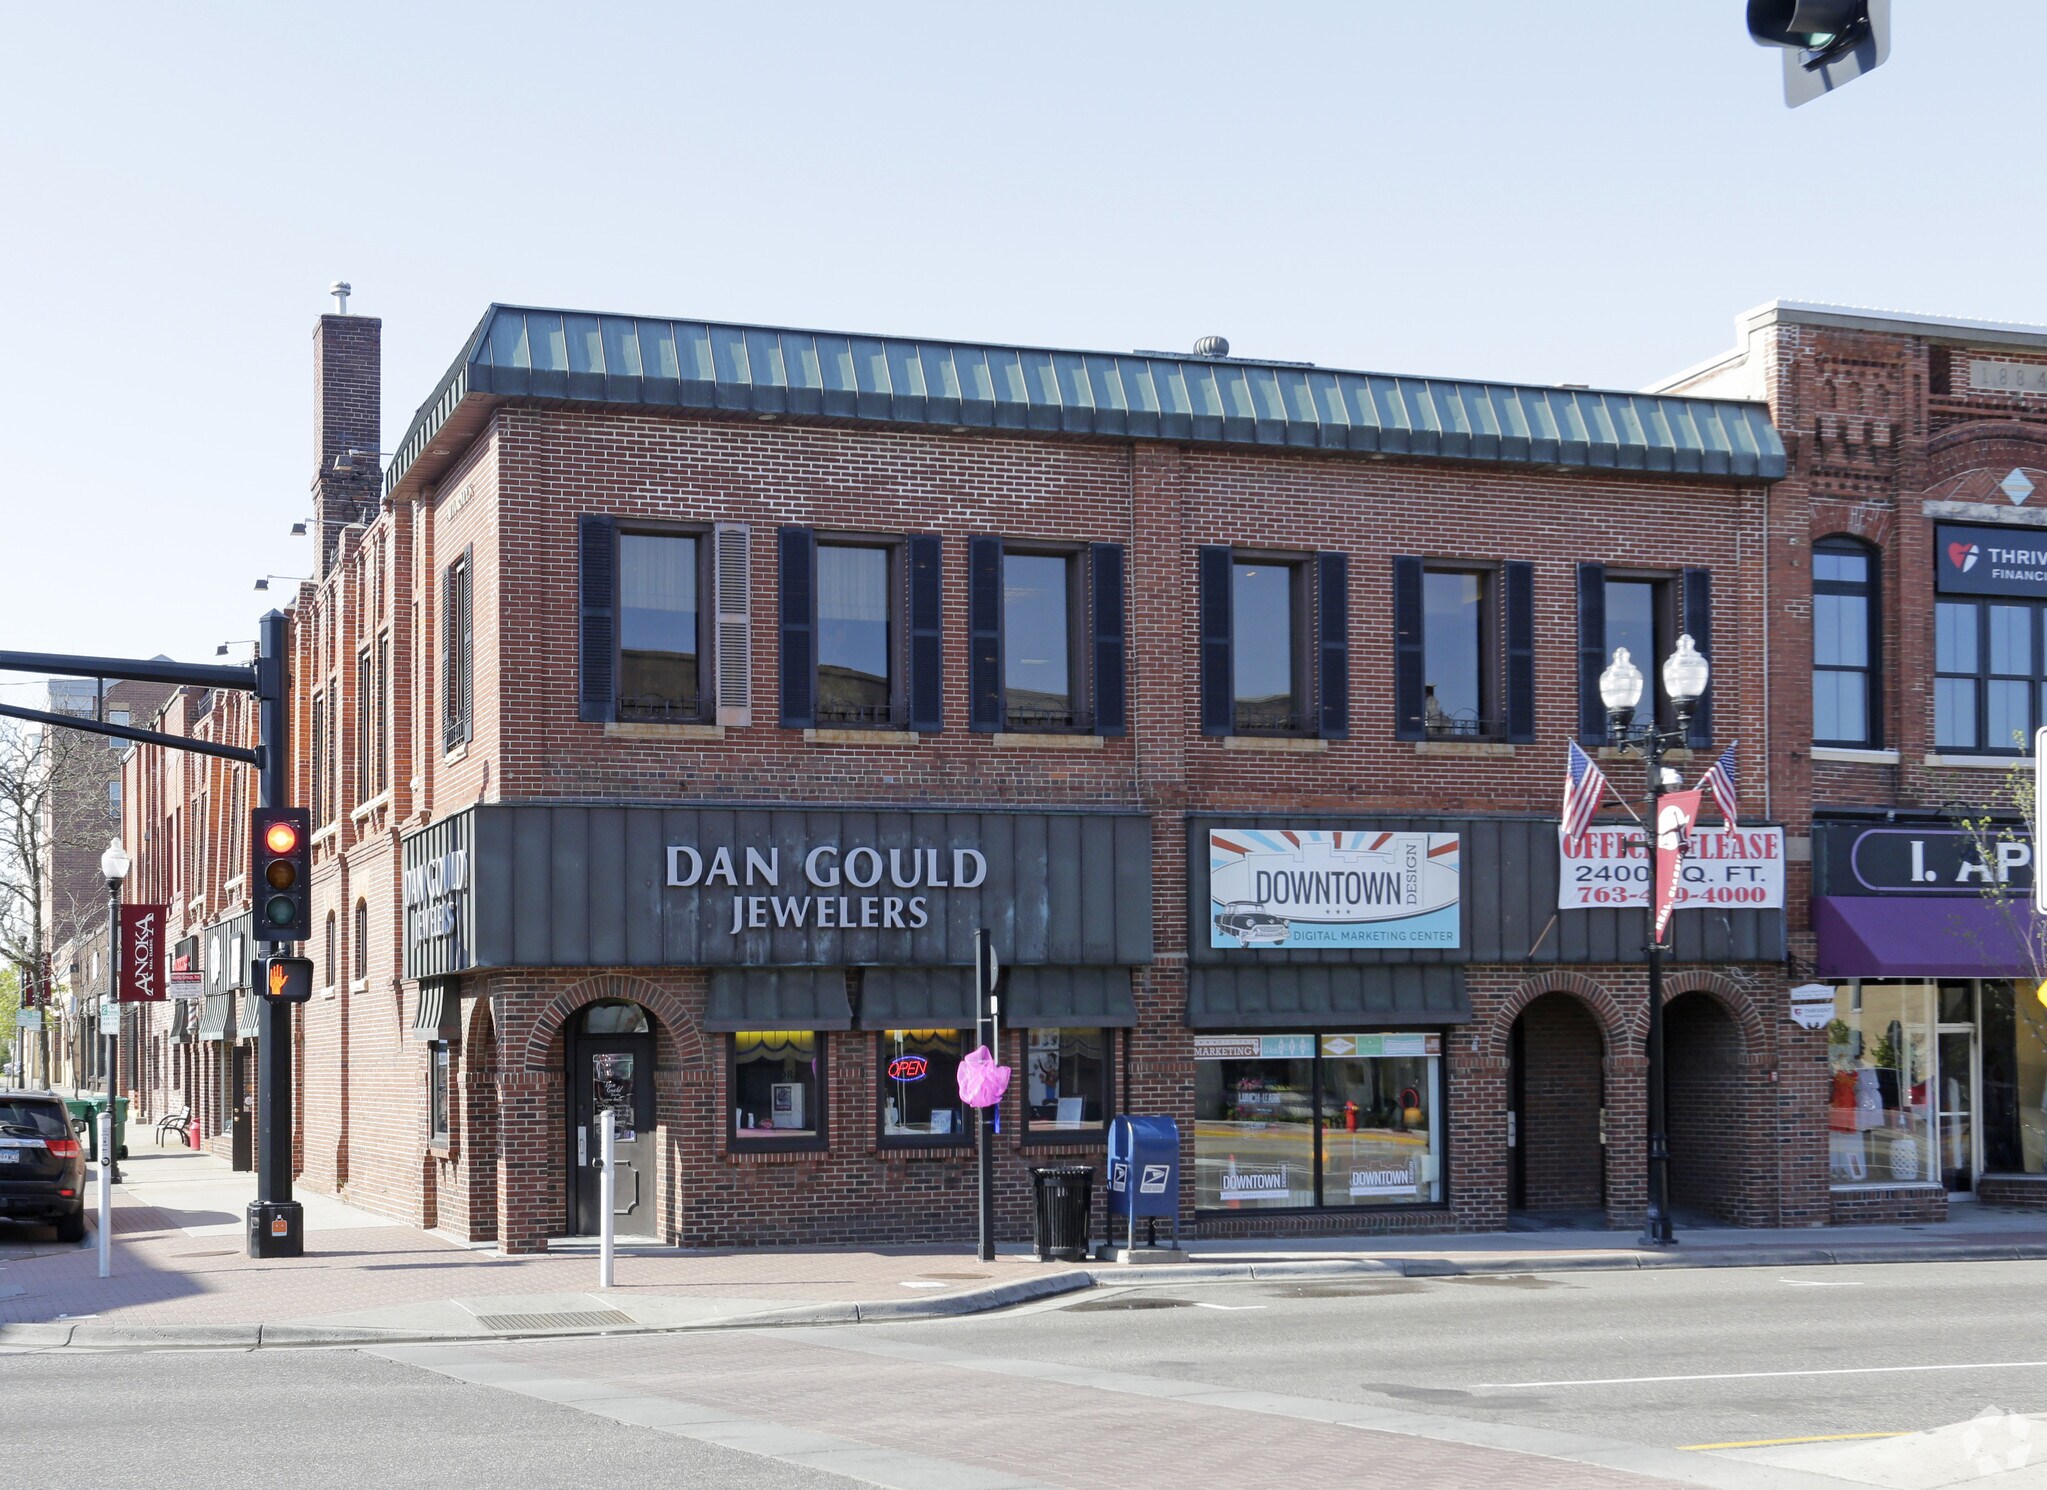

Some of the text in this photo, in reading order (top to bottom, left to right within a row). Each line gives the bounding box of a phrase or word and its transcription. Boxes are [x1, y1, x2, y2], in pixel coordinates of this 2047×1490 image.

[1563, 832, 1650, 859] OFFIC
[1700, 833, 1779, 860] LEASE
[666, 845, 987, 888] DAN GOULD
[1406, 843, 1417, 905] DESIGN
[1575, 865, 1650, 882] 2400
[1726, 867, 1766, 882] FT.
[404, 864, 426, 908] DAN
[1256, 870, 1401, 905] DOWNTOWN
[1577, 886, 1767, 904] 763-49-4000
[730, 896, 928, 934] JEWELERS
[1293, 930, 1454, 941] DIGITAL MARKETING CENTER
[135, 912, 154, 997] ANOKA
[1195, 1046, 1252, 1056] MARKETING
[888, 1061, 928, 1077] OPEN
[1222, 1174, 1281, 1190] DOWNTOWN
[1352, 1170, 1408, 1186] DOWNTOWN
